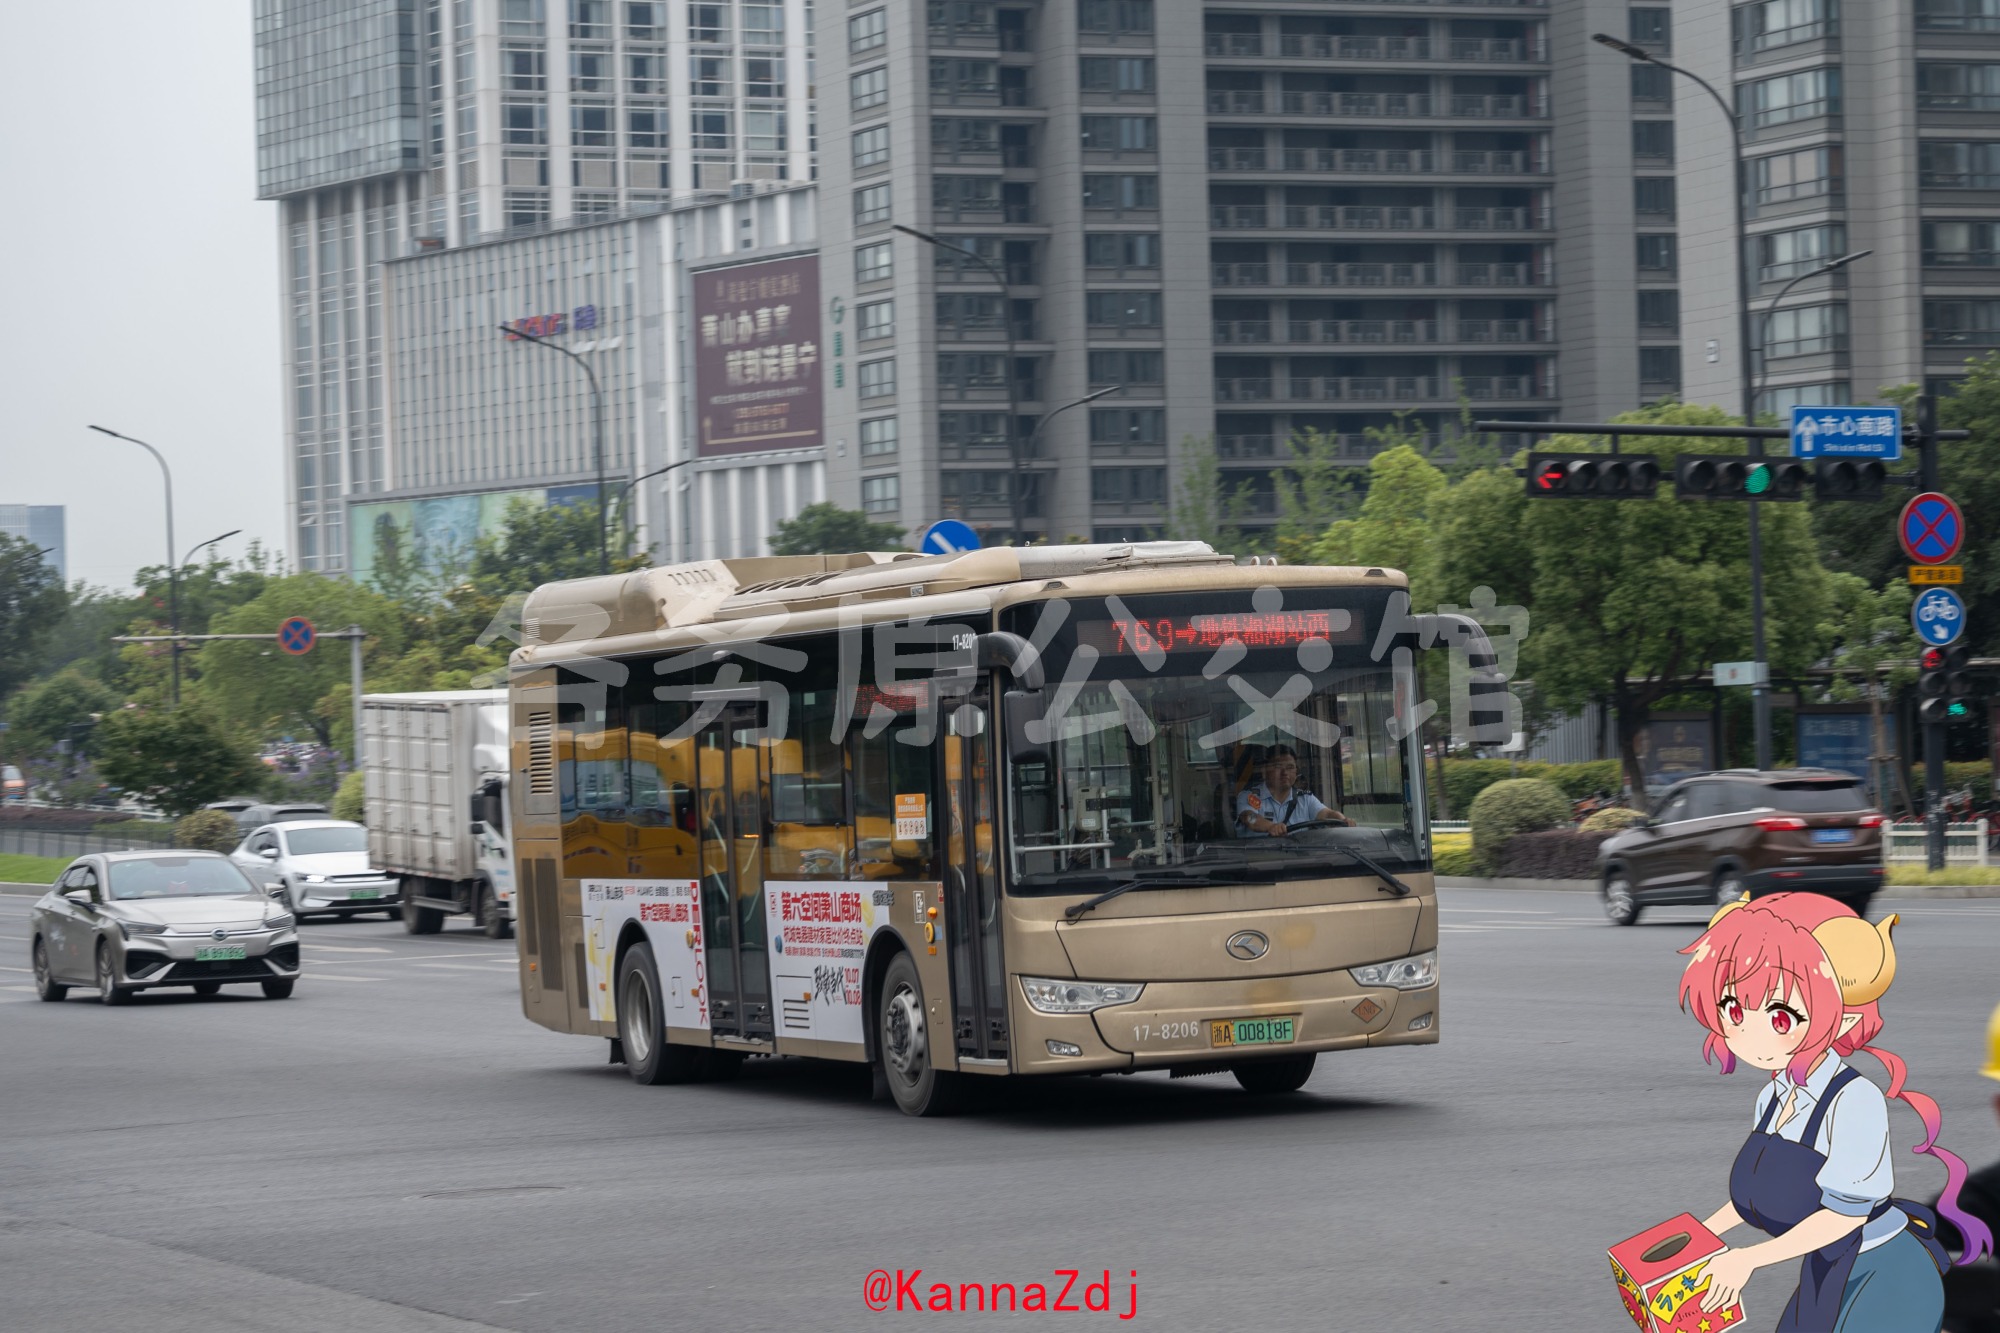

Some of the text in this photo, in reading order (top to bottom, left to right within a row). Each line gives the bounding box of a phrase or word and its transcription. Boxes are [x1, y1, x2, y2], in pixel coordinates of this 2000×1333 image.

[1818, 415, 1895, 436] 市心南路
[1112, 618, 1173, 653] 769
[781, 890, 862, 923] 第六空间萧山商场
[1358, 1004, 1376, 1016] LNG
[1133, 1021, 1199, 1041] 17-8206
